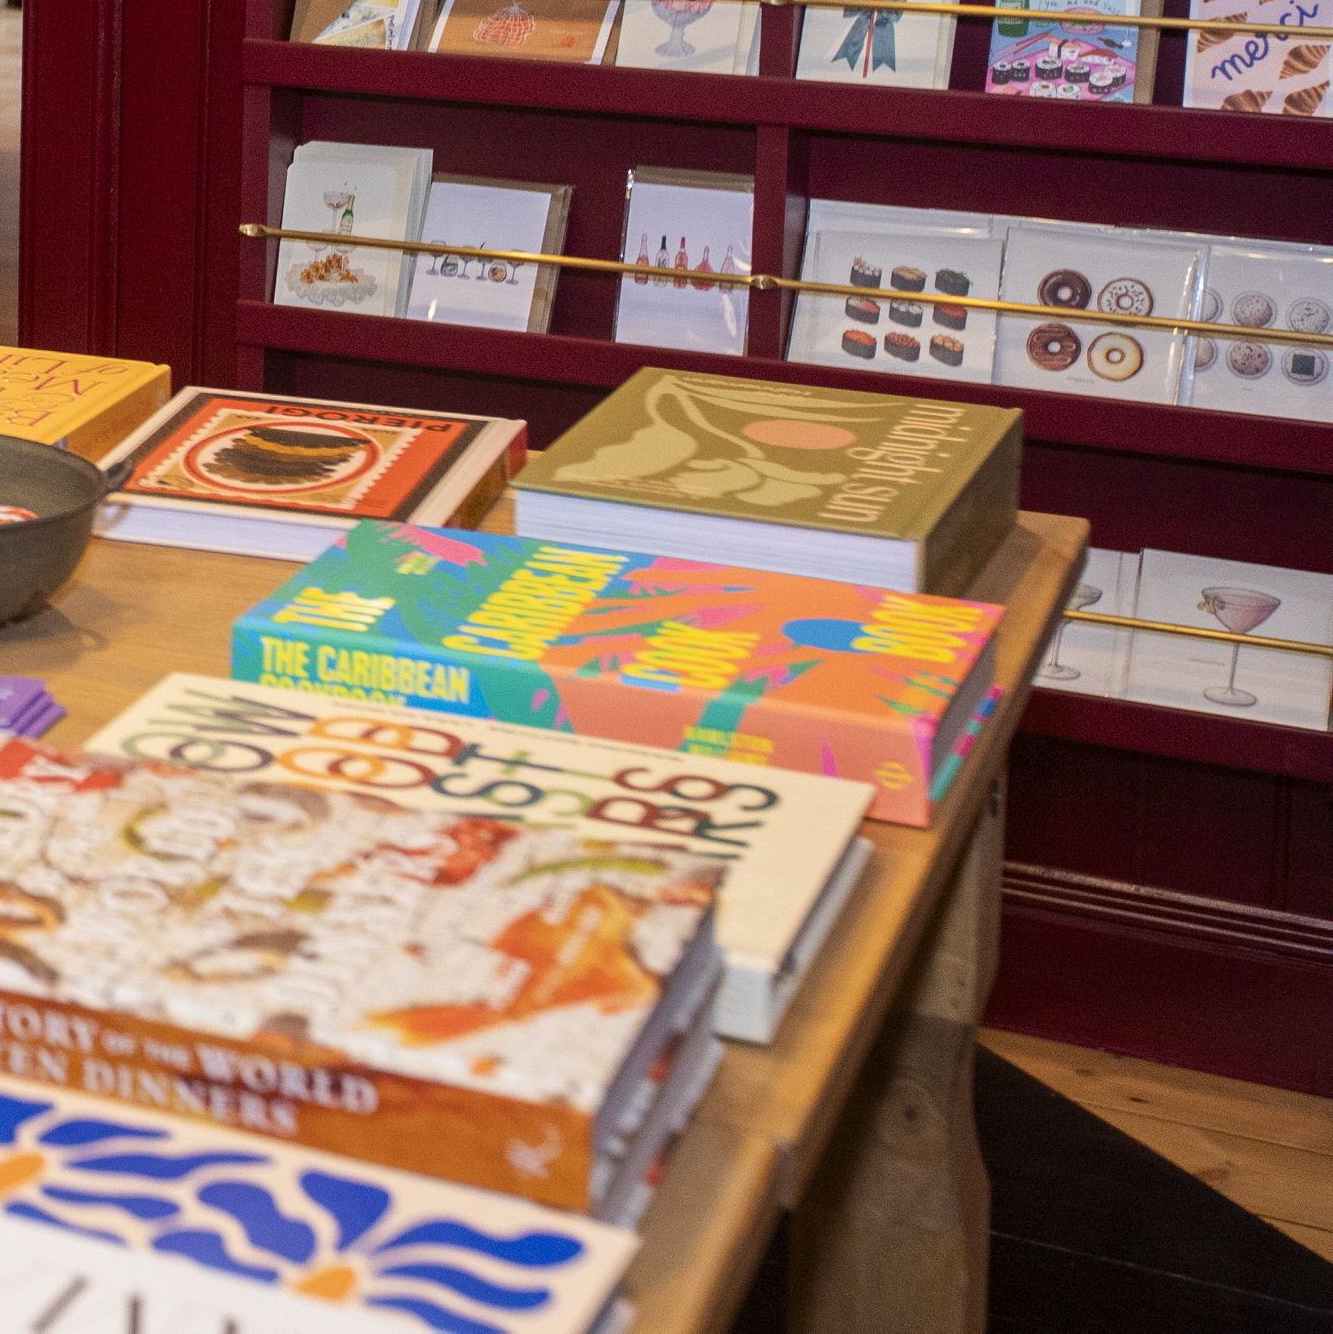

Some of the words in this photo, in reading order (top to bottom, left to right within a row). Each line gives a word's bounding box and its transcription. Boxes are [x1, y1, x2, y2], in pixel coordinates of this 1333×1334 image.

[263, 403, 454, 434] PIEROGI
[845, 402, 972, 485] midnight
[817, 484, 900, 523] sun
[274, 586, 396, 634] THE
[441, 544, 633, 662] CARIBBEAN
[851, 594, 987, 665] BOOK
[260, 636, 311, 677] THE
[317, 644, 472, 703] CARIBBEAN
[617, 620, 762, 691] COOK
[82, 1060, 301, 1139] DINNERS
[196, 1041, 381, 1117] WORLD
